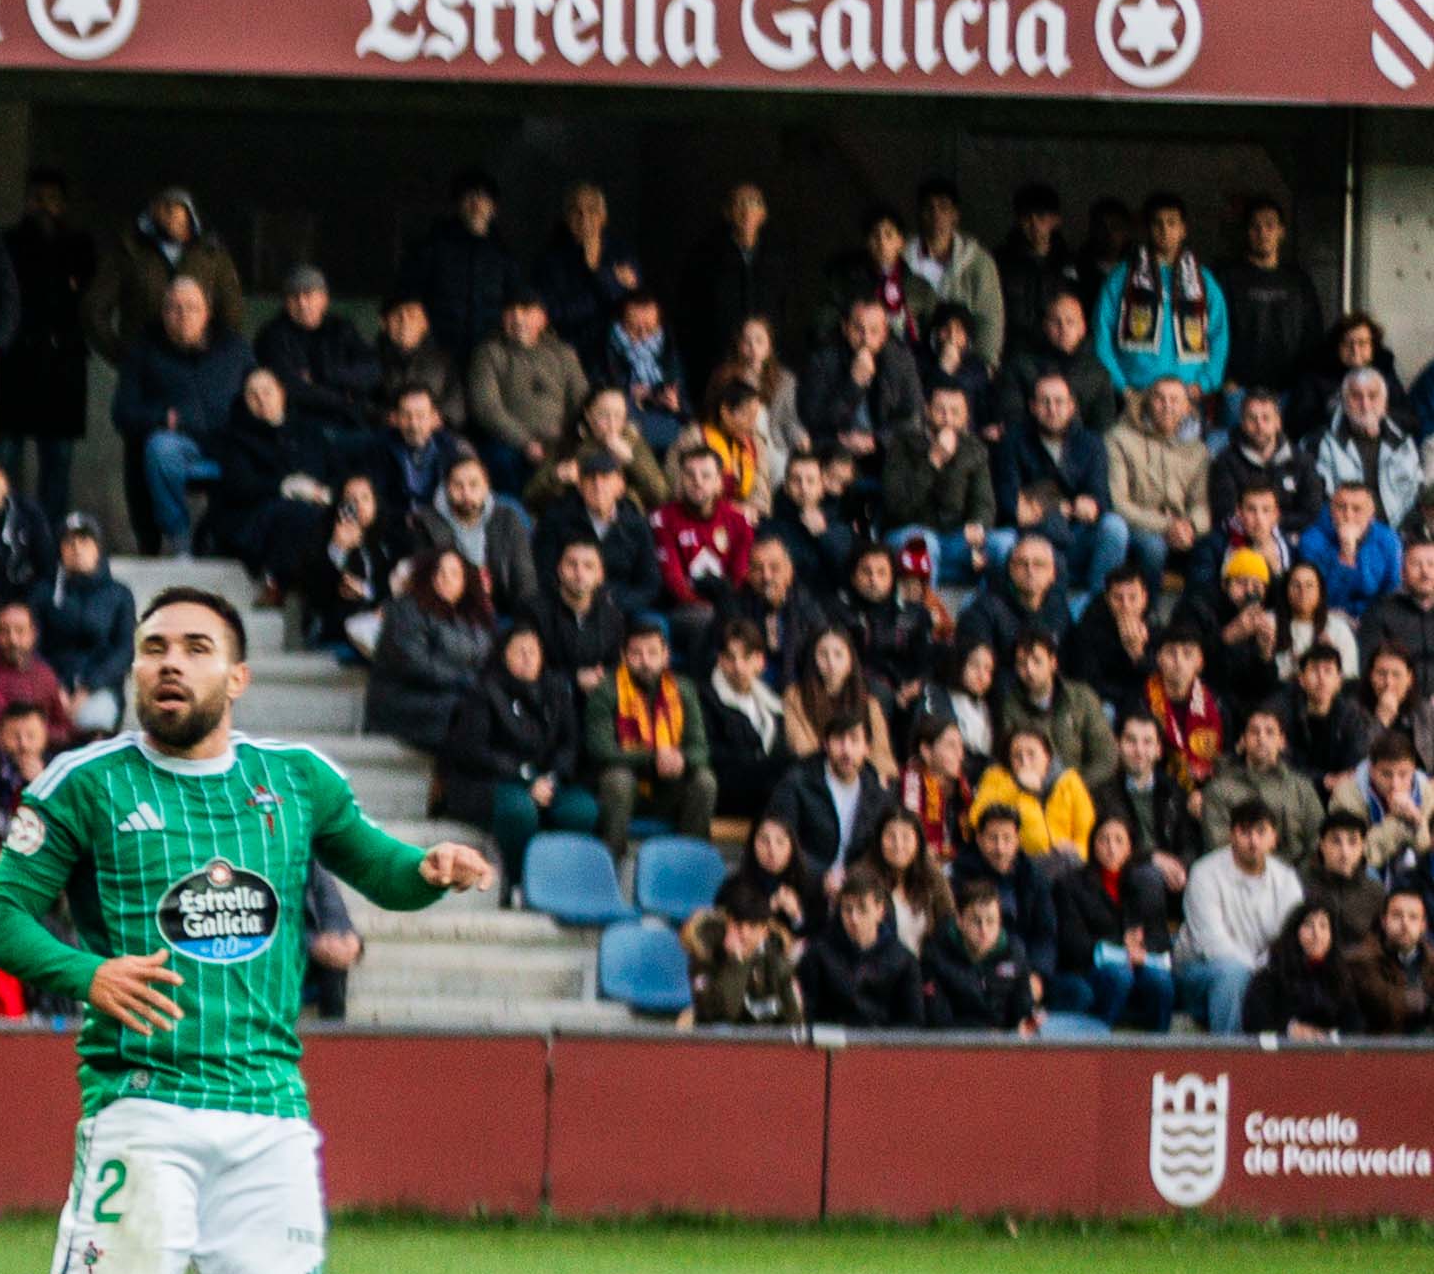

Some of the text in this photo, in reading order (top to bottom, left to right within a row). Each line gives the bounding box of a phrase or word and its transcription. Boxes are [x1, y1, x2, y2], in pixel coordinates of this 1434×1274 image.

[179, 886, 267, 914] Estrella
[182, 910, 264, 938] Galicia
[1244, 1112, 1359, 1145] Concello
[1244, 1142, 1432, 1177] de Pontevedra
[92, 1159, 127, 1223] 2
